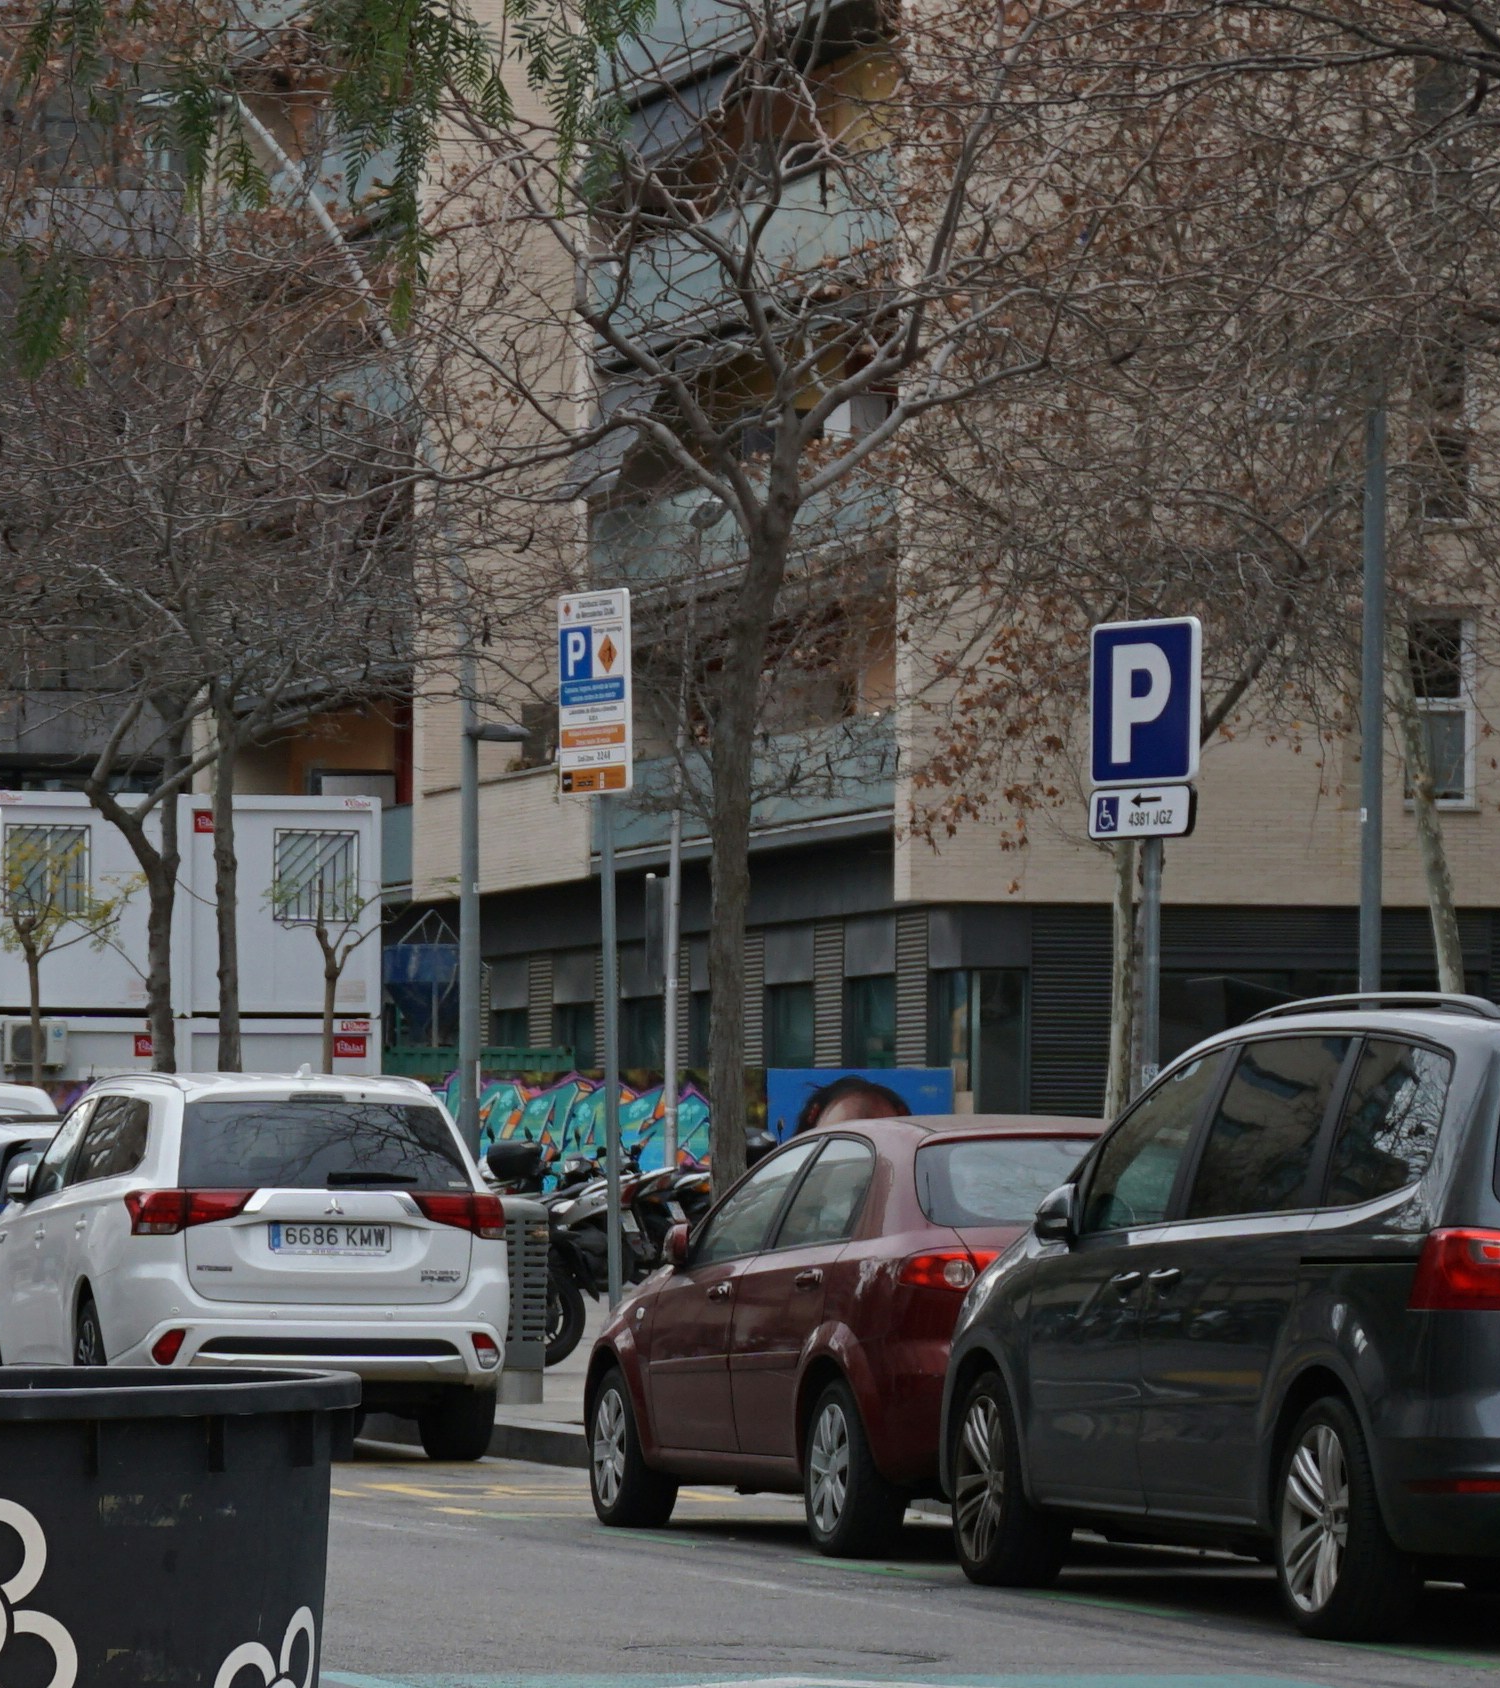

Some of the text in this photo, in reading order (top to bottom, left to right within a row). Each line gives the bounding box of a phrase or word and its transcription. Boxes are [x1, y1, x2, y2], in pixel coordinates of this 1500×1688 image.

[567, 631, 586, 678] P
[1111, 642, 1172, 764] P
[1129, 809, 1173, 827] 4381 JGZ
[285, 1226, 386, 1247] 6686 KMW
